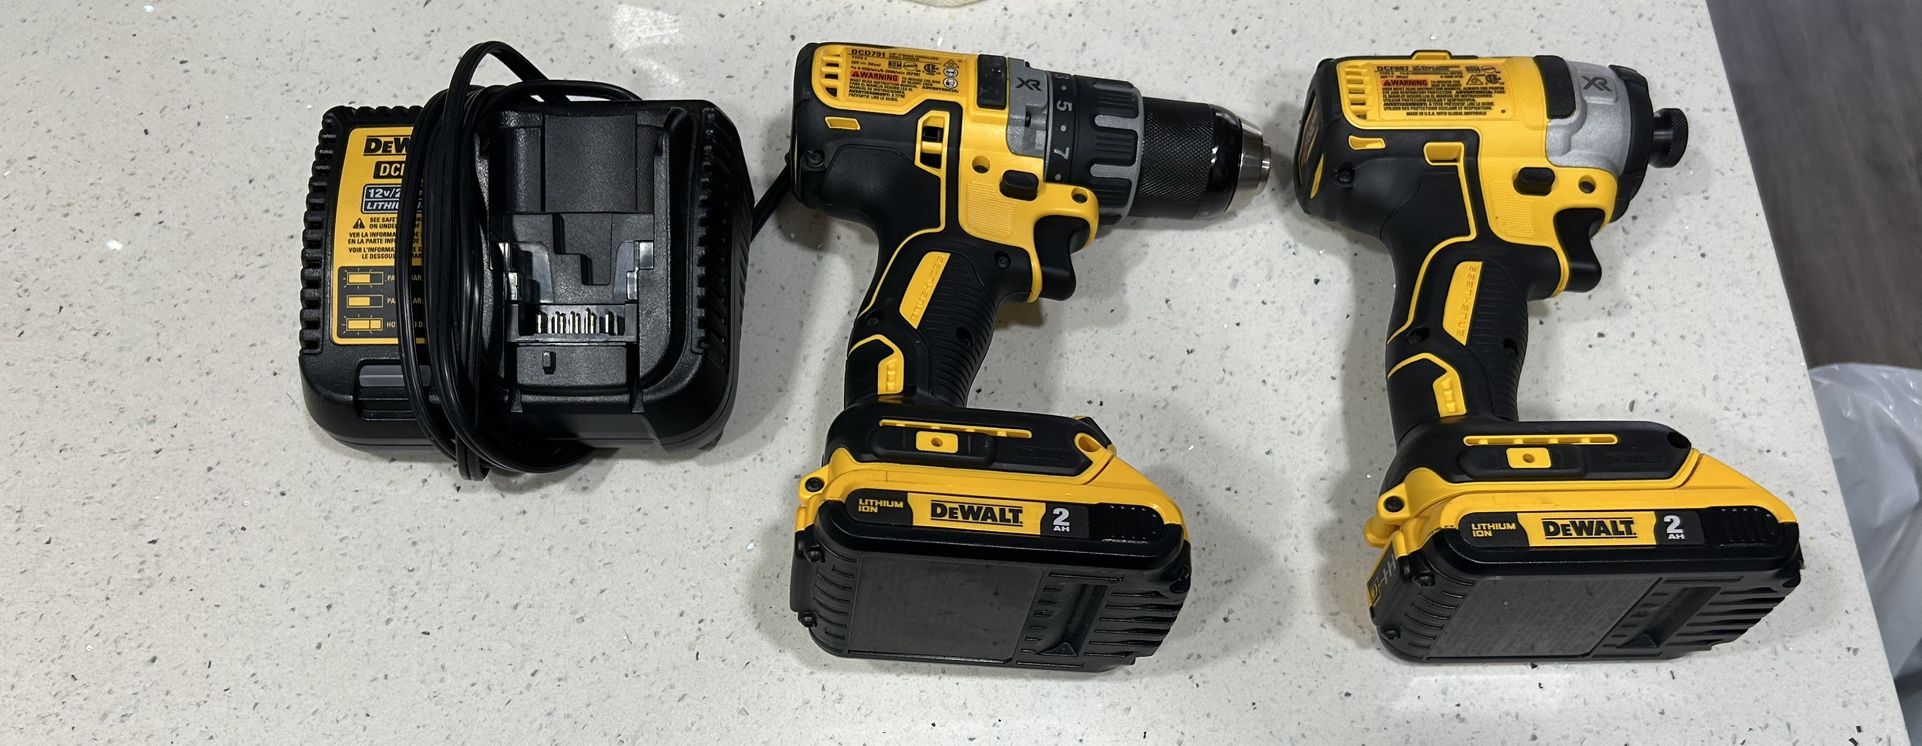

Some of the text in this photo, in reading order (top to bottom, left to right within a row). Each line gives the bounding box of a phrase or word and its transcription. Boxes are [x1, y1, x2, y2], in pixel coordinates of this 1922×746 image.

[860, 71, 898, 82] WARNING
[1016, 77, 1042, 91] XR
[1581, 75, 1613, 92] XR
[1056, 100, 1073, 111] 5
[1053, 147, 1070, 160] 7
[858, 498, 904, 508] LITHIUM
[858, 505, 878, 513] ION
[1053, 508, 1070, 526] 2
[1471, 522, 1516, 530] LITHIUM
[1663, 515, 1684, 534] 2
